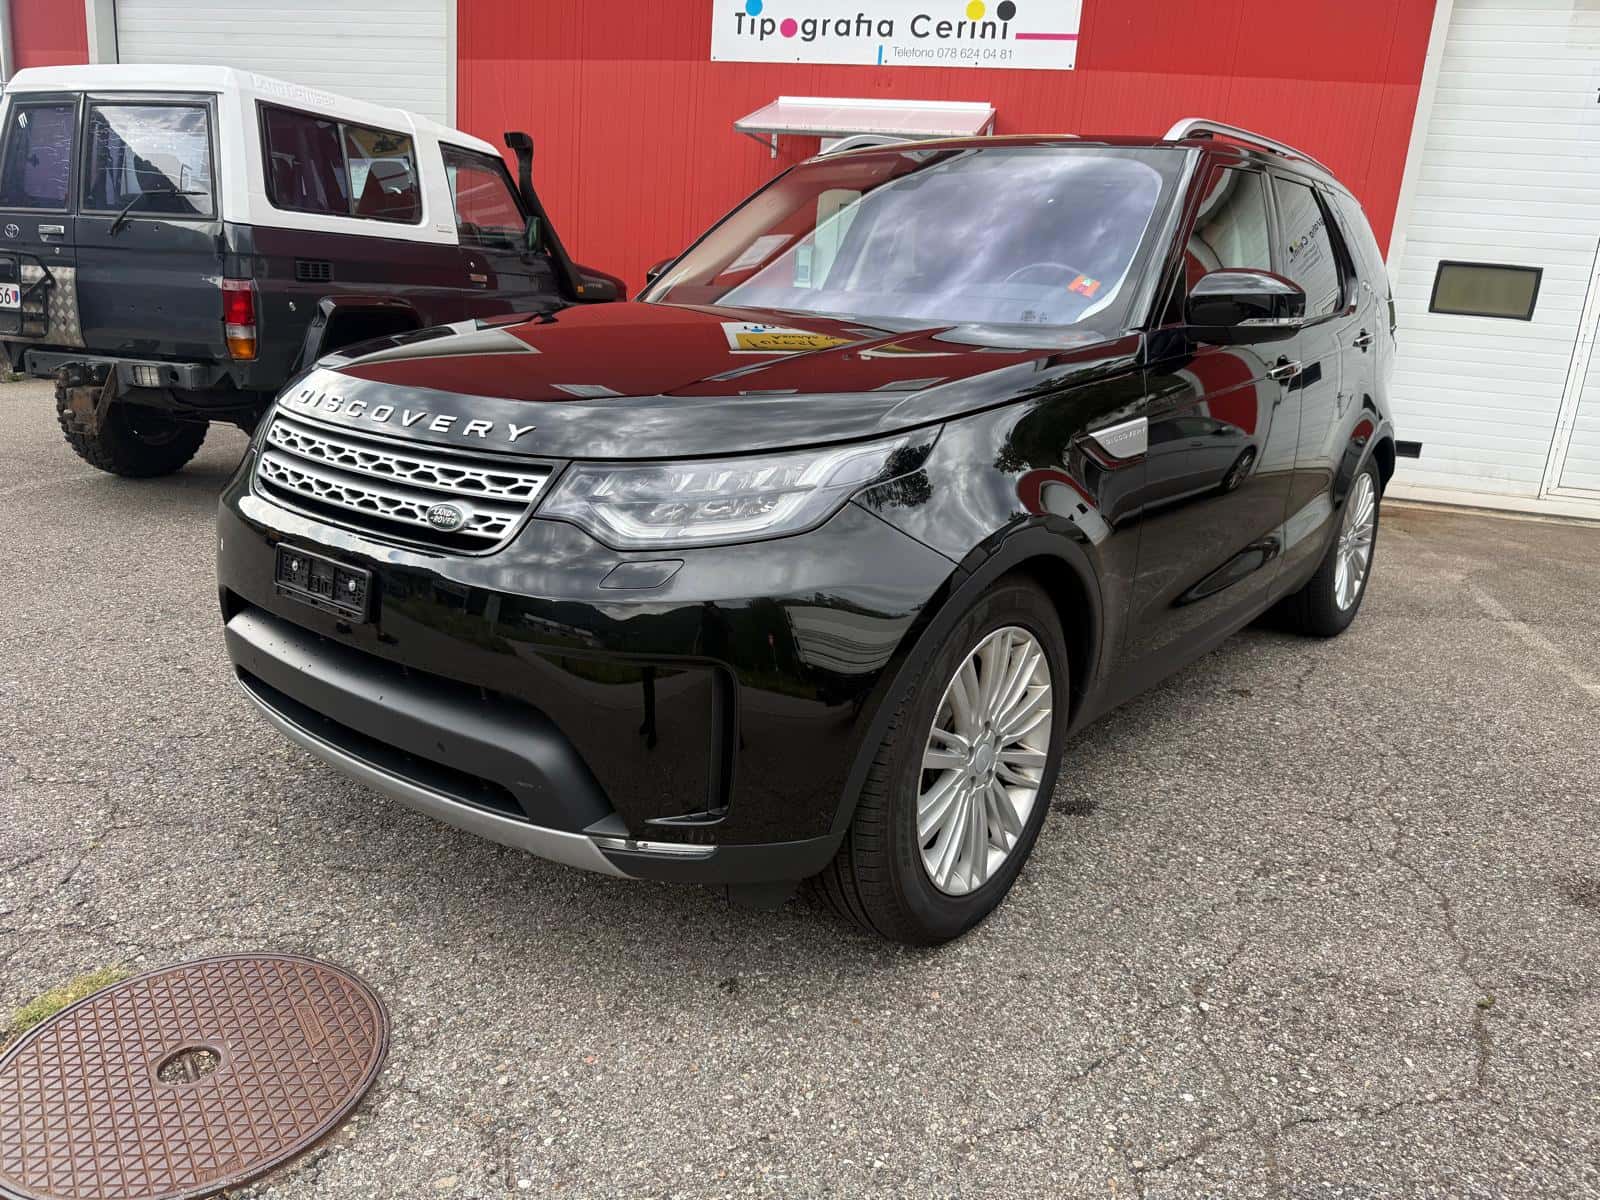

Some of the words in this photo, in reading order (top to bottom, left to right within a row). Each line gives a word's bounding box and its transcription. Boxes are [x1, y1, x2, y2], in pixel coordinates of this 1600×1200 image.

[735, 7, 894, 42] Tipografia
[910, 7, 1009, 40] Cerini
[893, 46, 935, 58] Telefono
[937, 47, 957, 59] 078
[960, 48, 980, 59] 624
[983, 48, 997, 60] 04
[1000, 49, 1013, 60] 81
[296, 388, 537, 442] DISCOVERY
